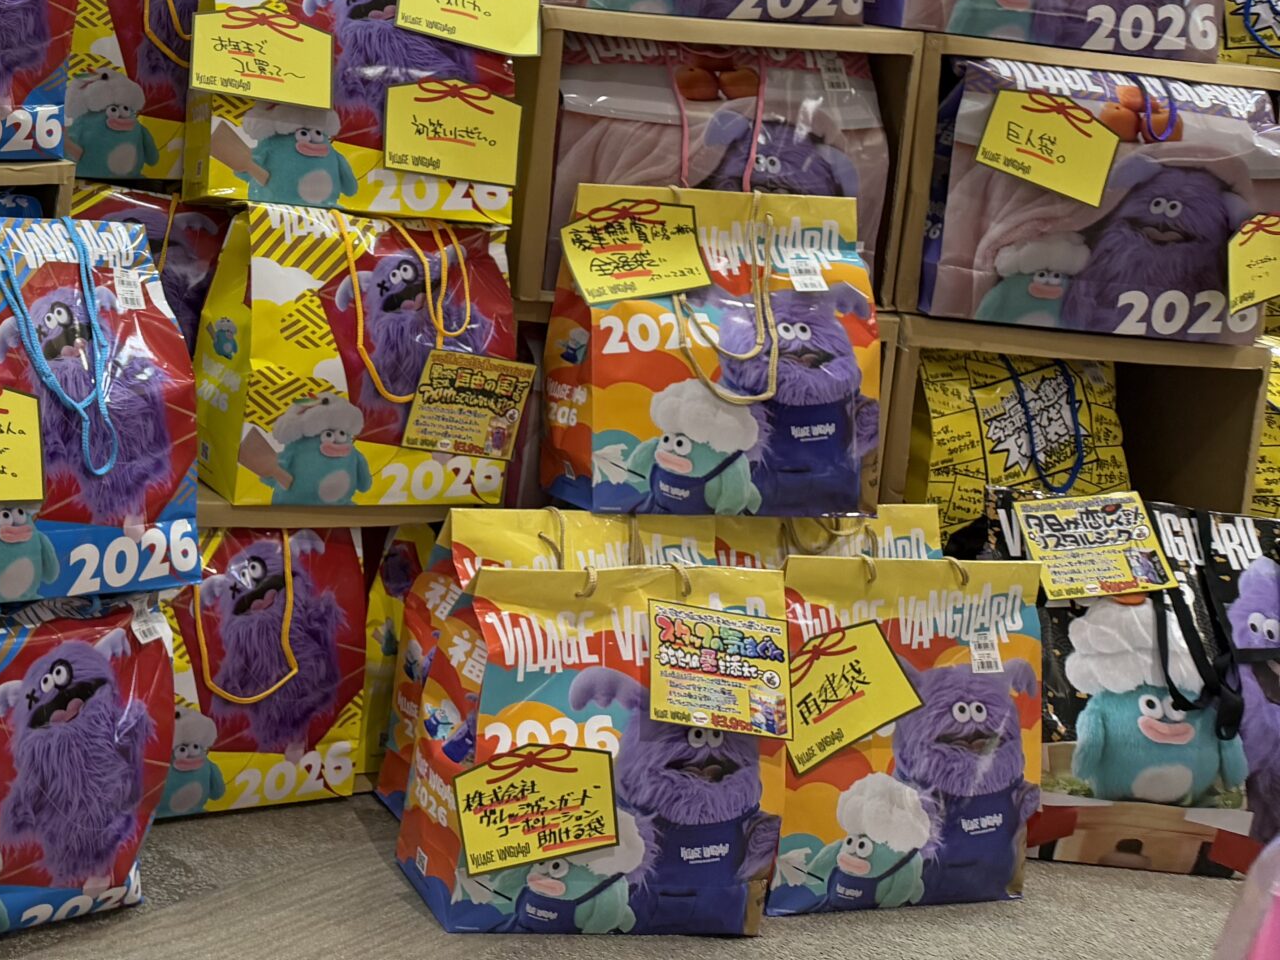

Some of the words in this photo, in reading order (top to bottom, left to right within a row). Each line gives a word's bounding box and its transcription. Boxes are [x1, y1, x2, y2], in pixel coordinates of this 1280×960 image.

[401, 11, 425, 28] VILLAGE
[426, 18, 456, 35] VANGUARD
[1081, 4, 1219, 50] 2026
[195, 72, 219, 87] VILLAGE
[219, 78, 252, 92] VANGUARD
[388, 152, 410, 167] VILLAGE
[411, 156, 441, 170] VANGUARD
[368, 167, 512, 213] 2026
[700, 216, 842, 276] VANGUARD
[599, 312, 720, 355] 2026
[1112, 288, 1258, 336] 2026
[377, 458, 504, 505] 2026
[65, 518, 196, 596] 2026
[898, 583, 1024, 649] VANGUARD
[490, 610, 600, 683] VILLAGE
[796, 660, 872, 726] 再建袋
[484, 714, 622, 760] 2026
[794, 746, 817, 774] VILLAGE
[816, 728, 845, 755] VANGUARD
[234, 741, 355, 809] 2026
[462, 779, 540, 813] 株式会社
[469, 851, 496, 869] VILLAGE
[497, 842, 532, 862] VANGUARD
[535, 816, 607, 849] 助ける袋
